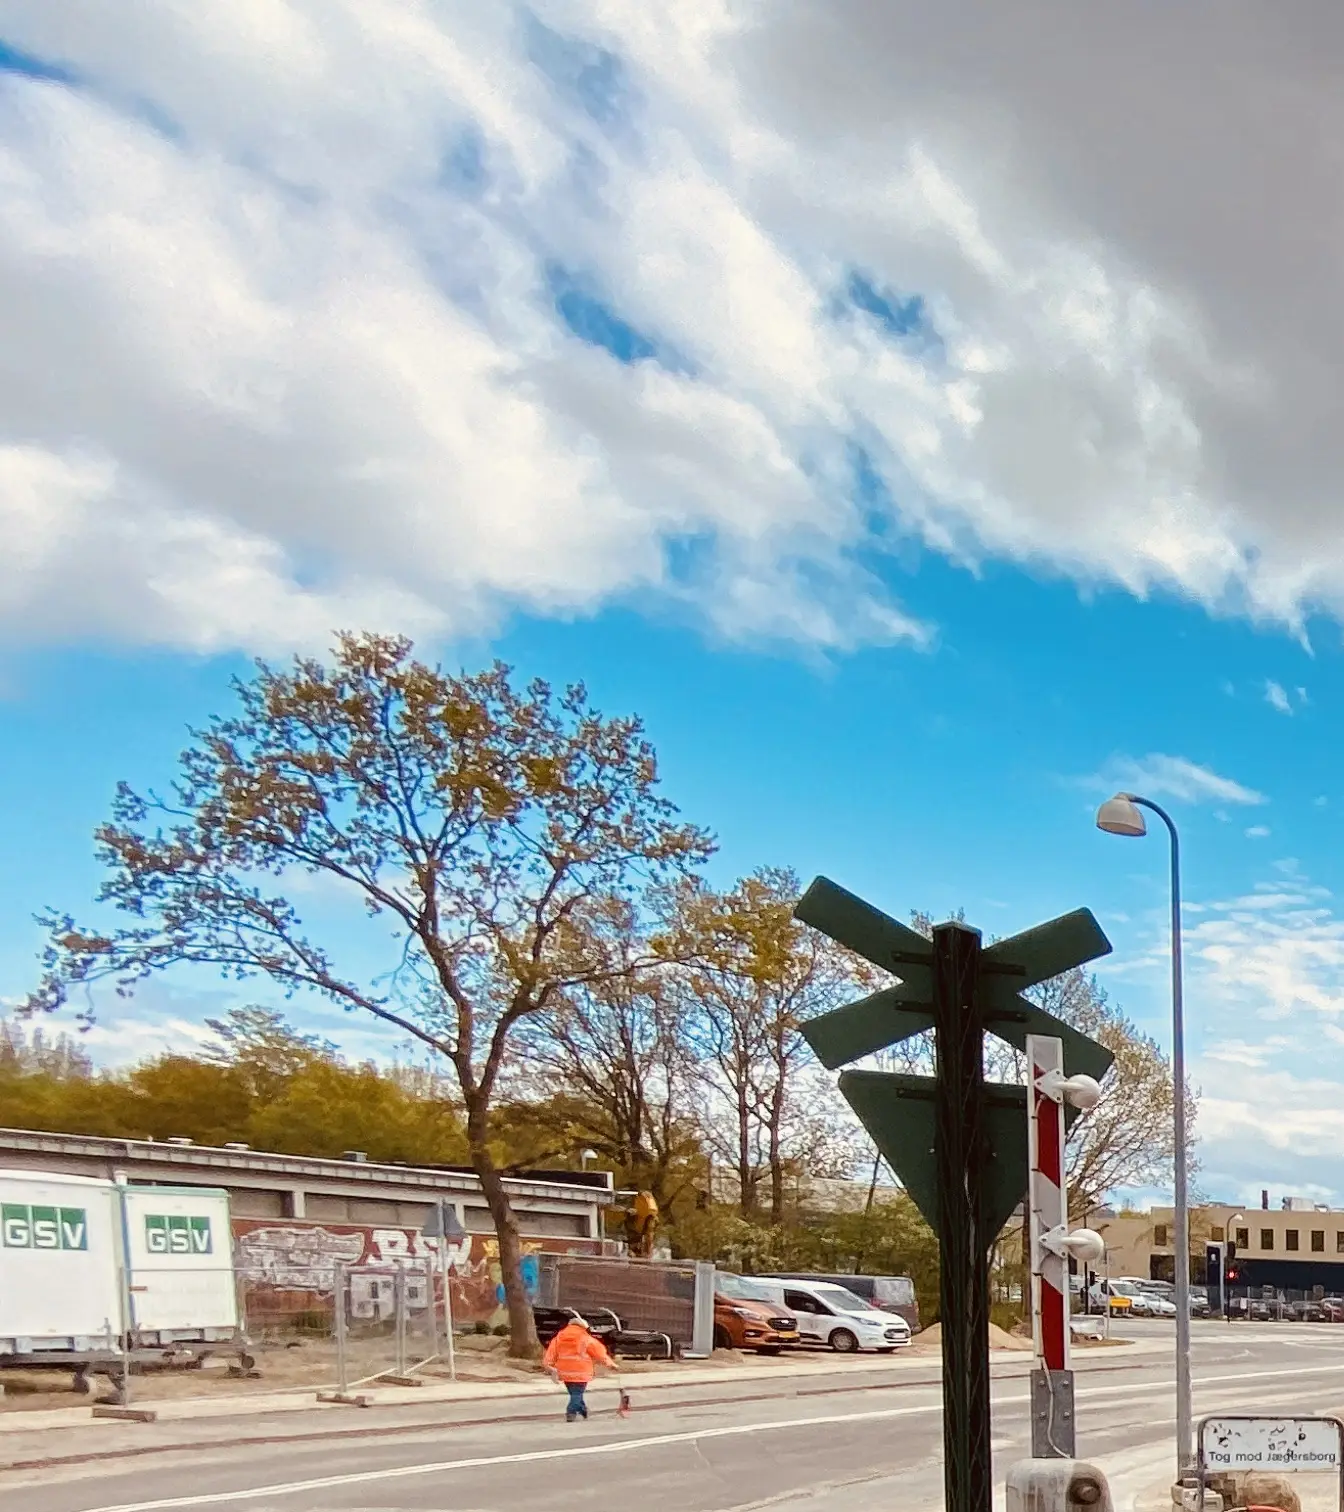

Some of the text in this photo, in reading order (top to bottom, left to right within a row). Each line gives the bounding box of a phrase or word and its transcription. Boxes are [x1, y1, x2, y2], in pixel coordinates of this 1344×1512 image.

[4, 1218, 84, 1248] GSV
[148, 1227, 209, 1252] GSV
[1209, 1451, 1231, 1463] Tog
[1235, 1451, 1262, 1462] mod
